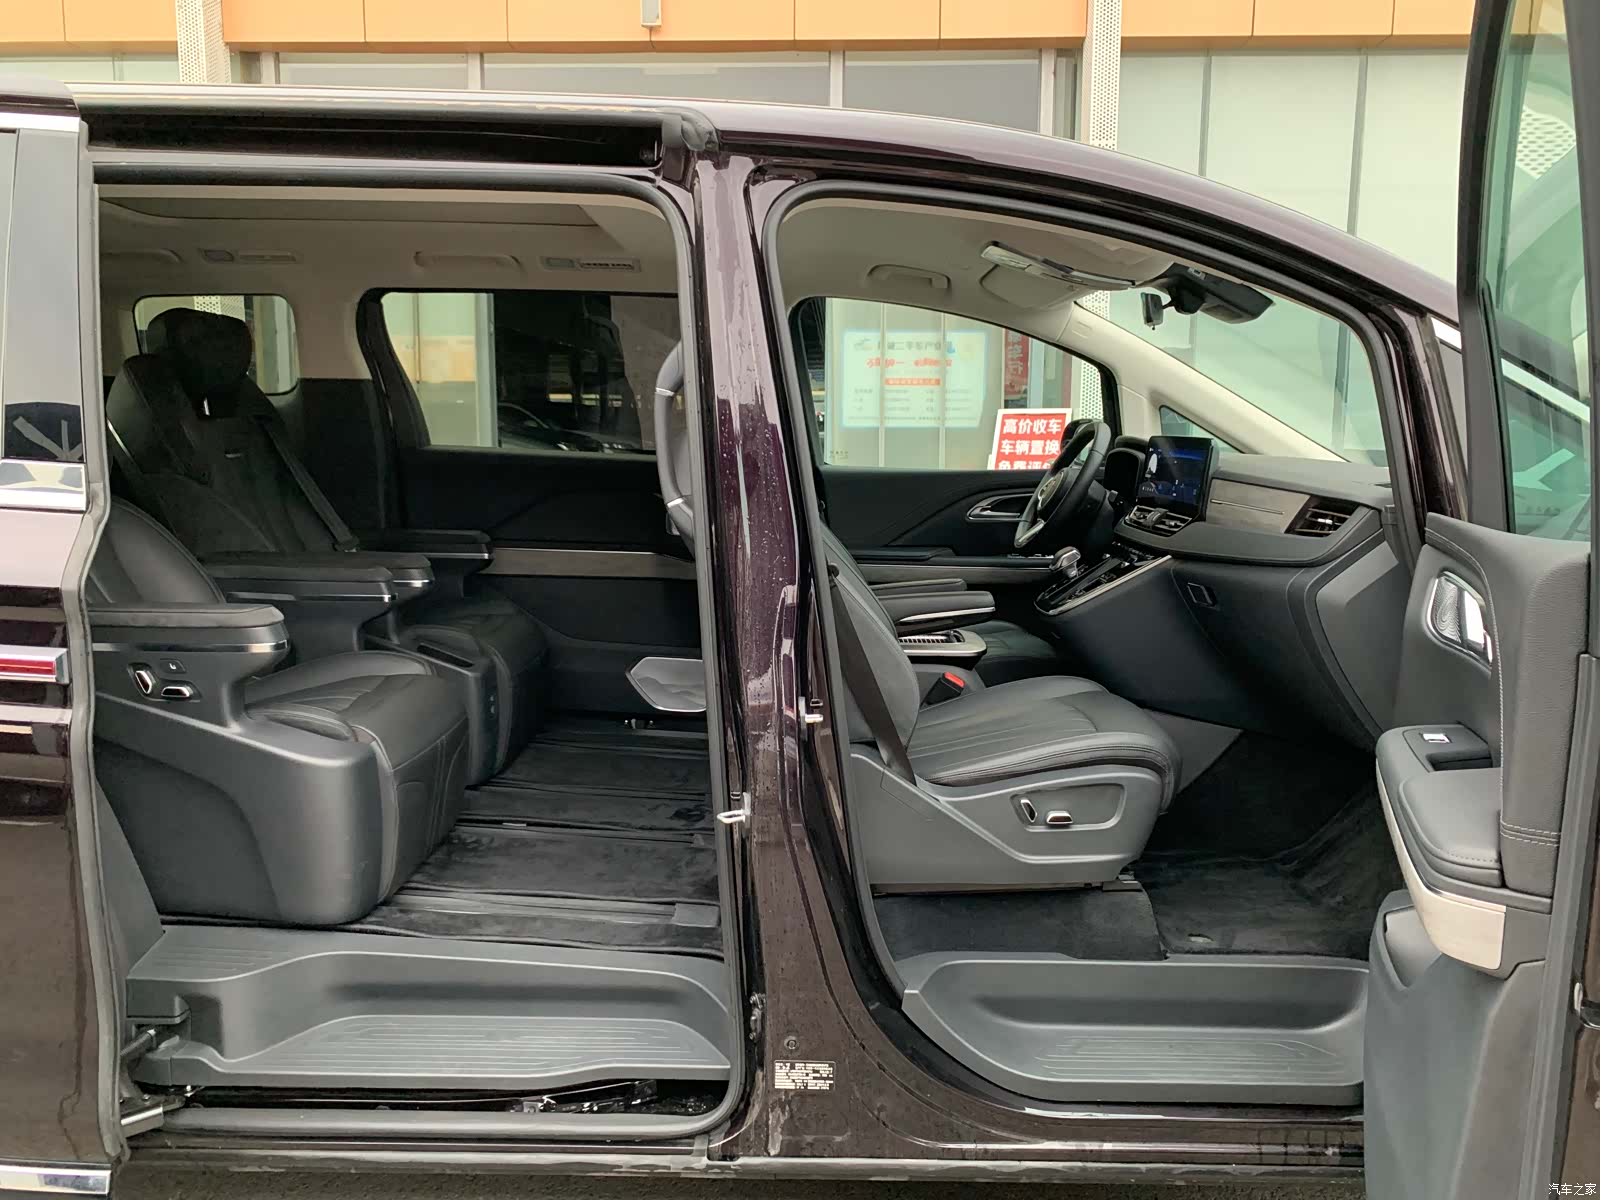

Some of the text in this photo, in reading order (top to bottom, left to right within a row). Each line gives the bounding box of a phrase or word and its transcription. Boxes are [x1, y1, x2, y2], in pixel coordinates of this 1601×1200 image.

[1003, 418, 1062, 435] 高价收车
[1000, 439, 1060, 456] 车辆置换
